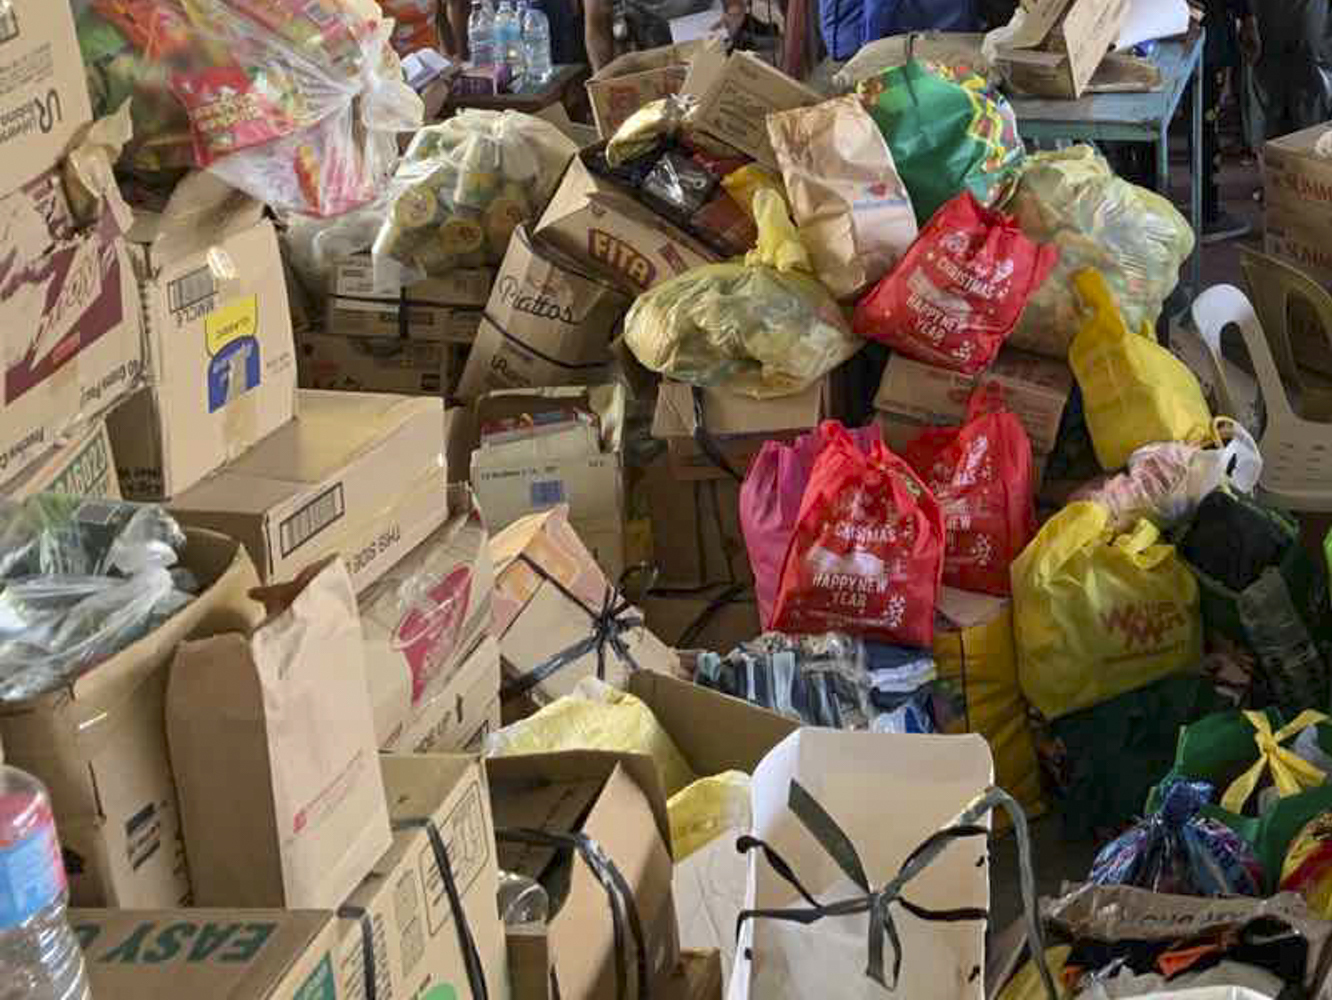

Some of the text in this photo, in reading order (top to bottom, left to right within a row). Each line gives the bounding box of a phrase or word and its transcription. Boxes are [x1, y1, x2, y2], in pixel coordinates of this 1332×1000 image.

[592, 229, 650, 286] FITA
[919, 319, 947, 348] YEAR
[813, 573, 857, 588] HAPPY
[832, 590, 868, 610] YEAR
[104, 921, 277, 962] EASY
